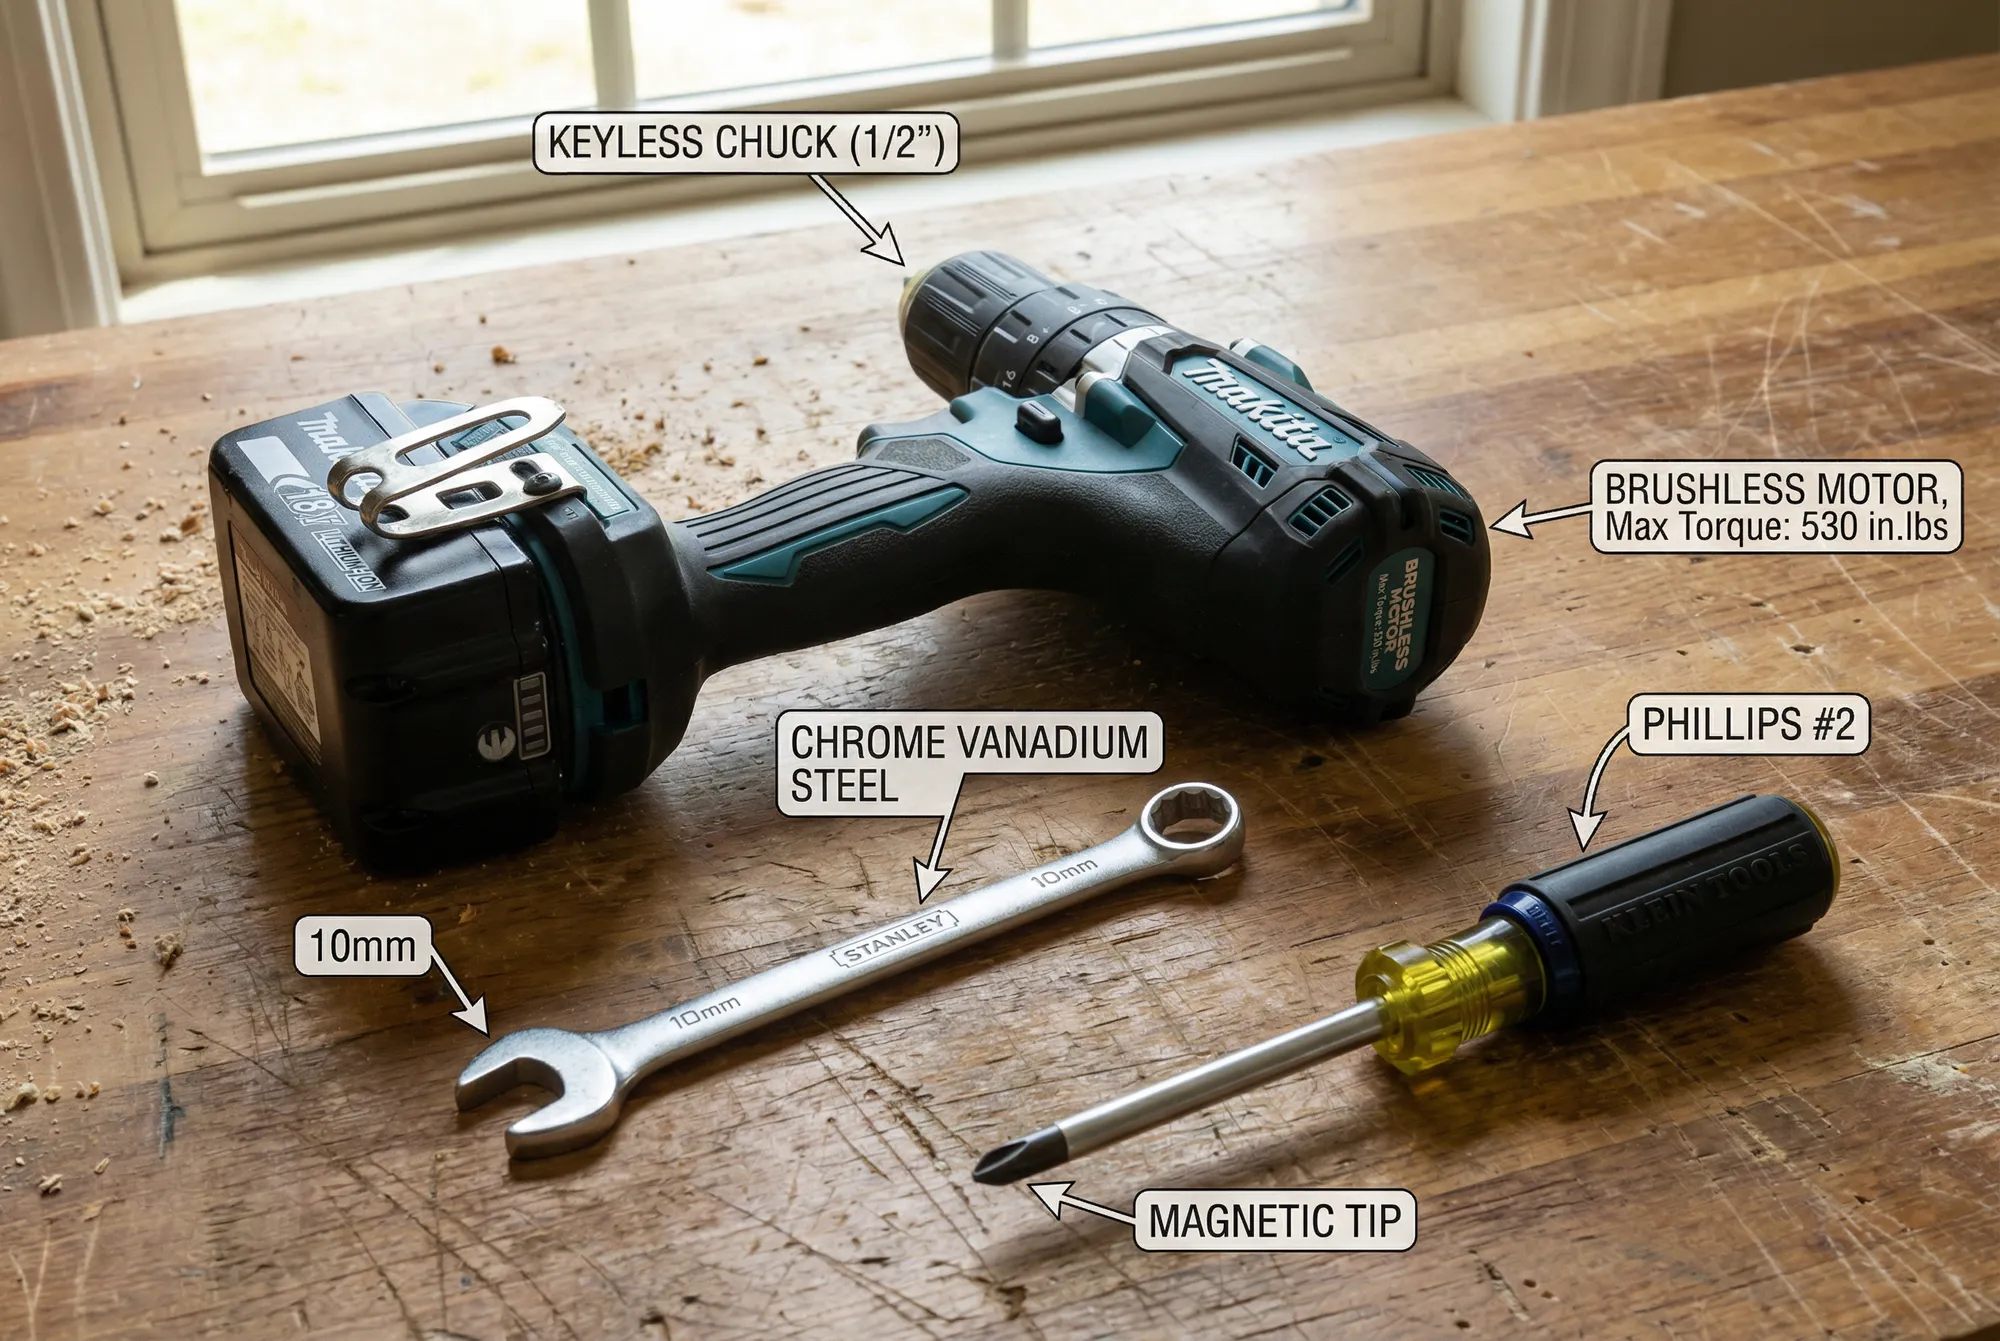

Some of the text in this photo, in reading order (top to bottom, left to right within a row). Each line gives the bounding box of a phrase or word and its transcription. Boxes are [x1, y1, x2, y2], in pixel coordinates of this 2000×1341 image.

[1394, 558, 1419, 672] BRUSHLESS
[1031, 857, 1099, 889] 10mm
[1601, 883, 1700, 942] KLEIN
[1705, 842, 1811, 900] TOOLS
[843, 914, 945, 963] STANLEY
[669, 997, 741, 1029] 10mm
